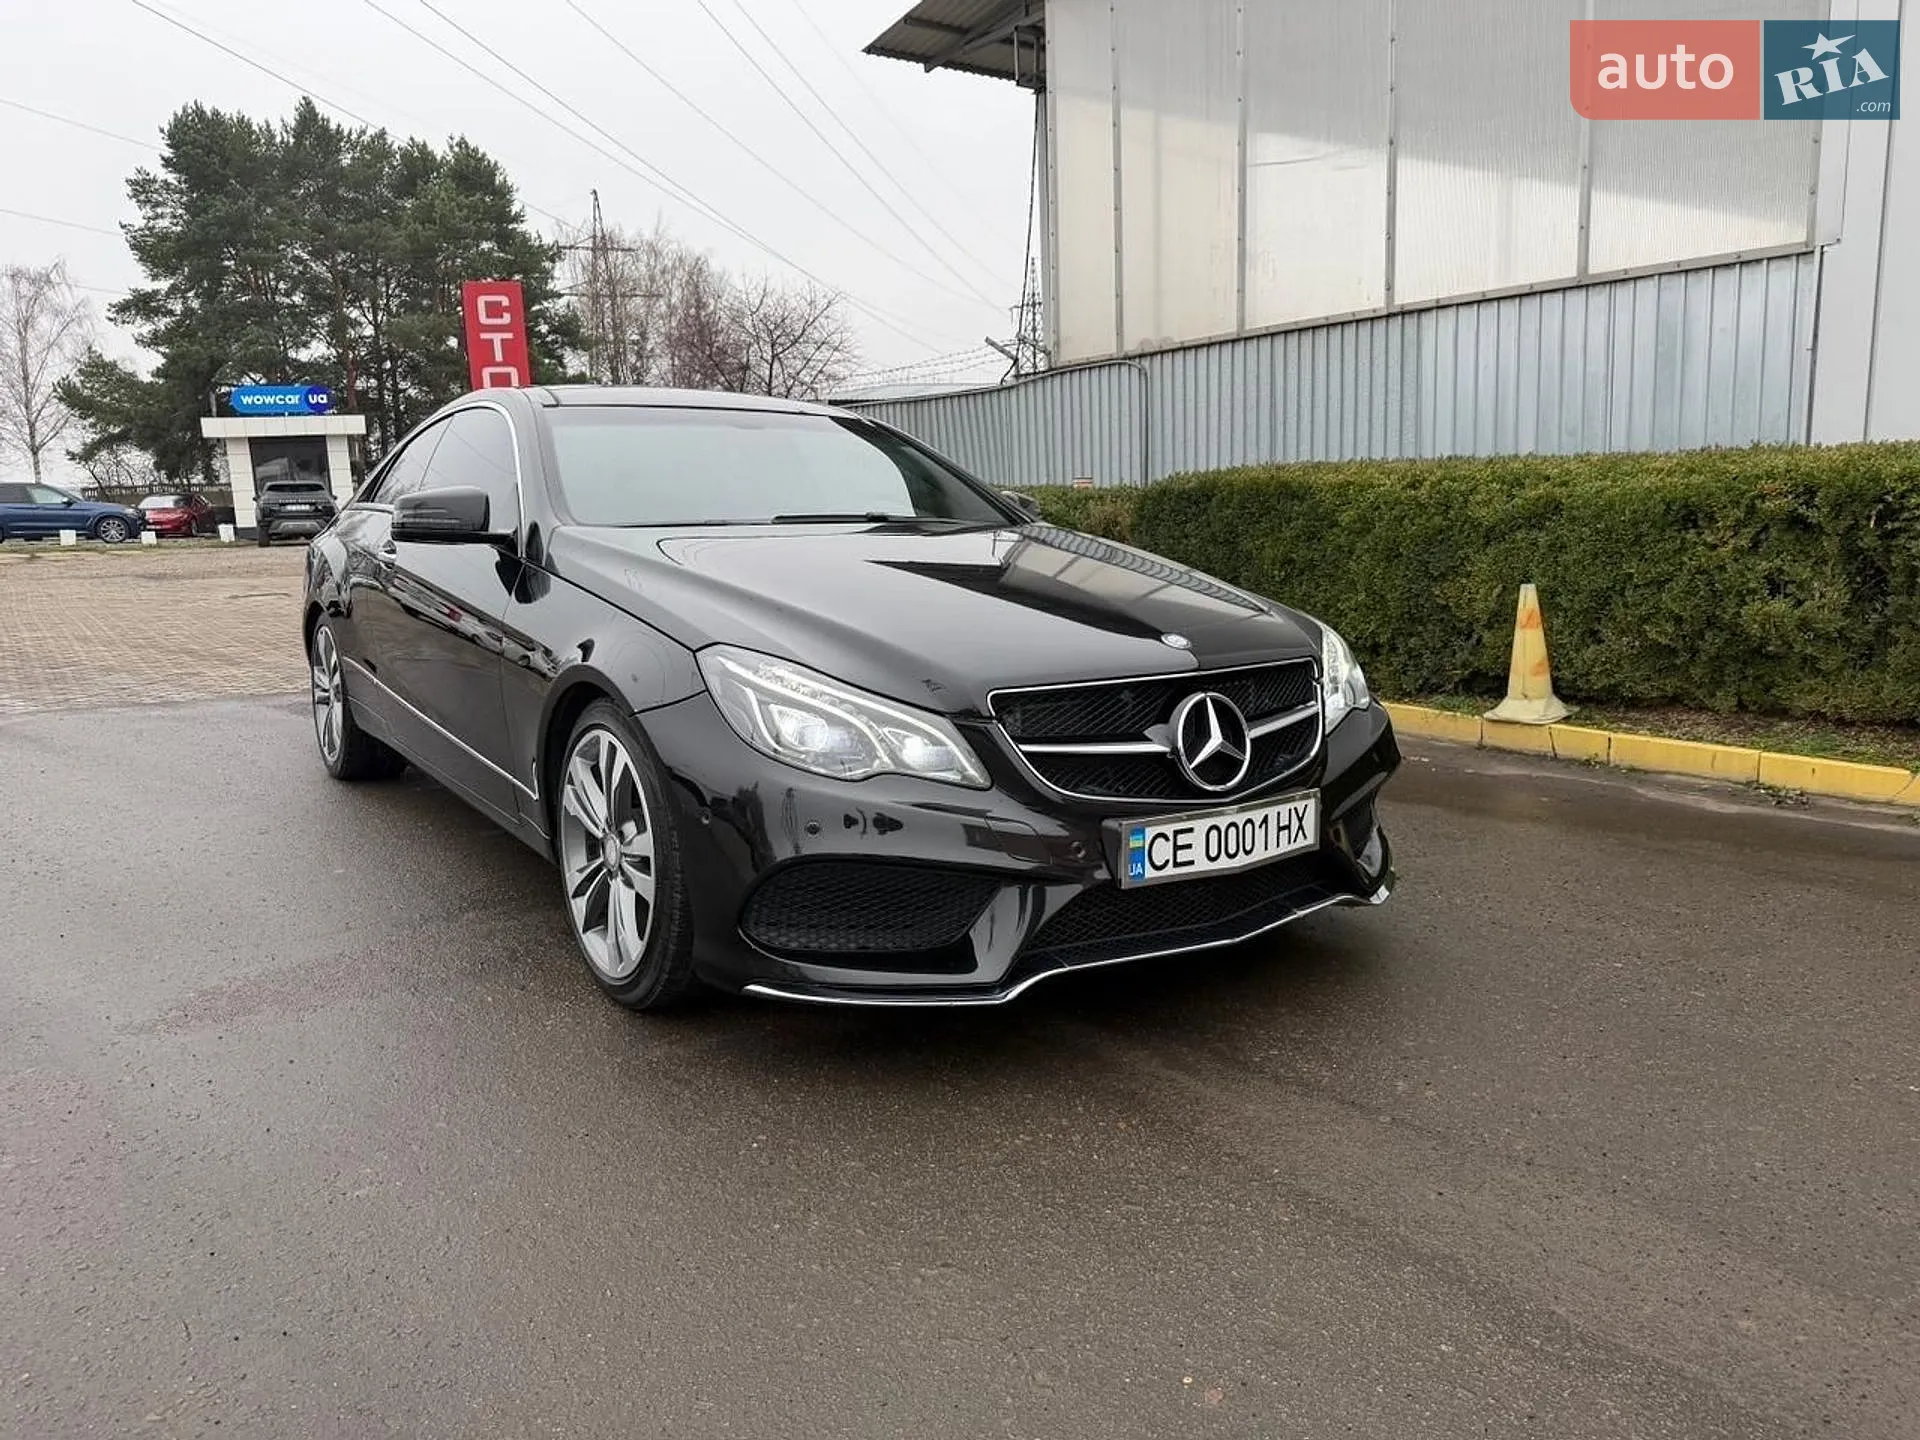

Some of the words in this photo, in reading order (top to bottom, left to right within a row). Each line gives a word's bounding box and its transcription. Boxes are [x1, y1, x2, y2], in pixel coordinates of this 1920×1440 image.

[240, 394, 300, 405] wowcar
[308, 394, 328, 404] ua
[1147, 827, 1195, 871] CE
[1205, 813, 1269, 862] 0001
[1276, 804, 1308, 848] HX
[1129, 863, 1144, 876] UA
